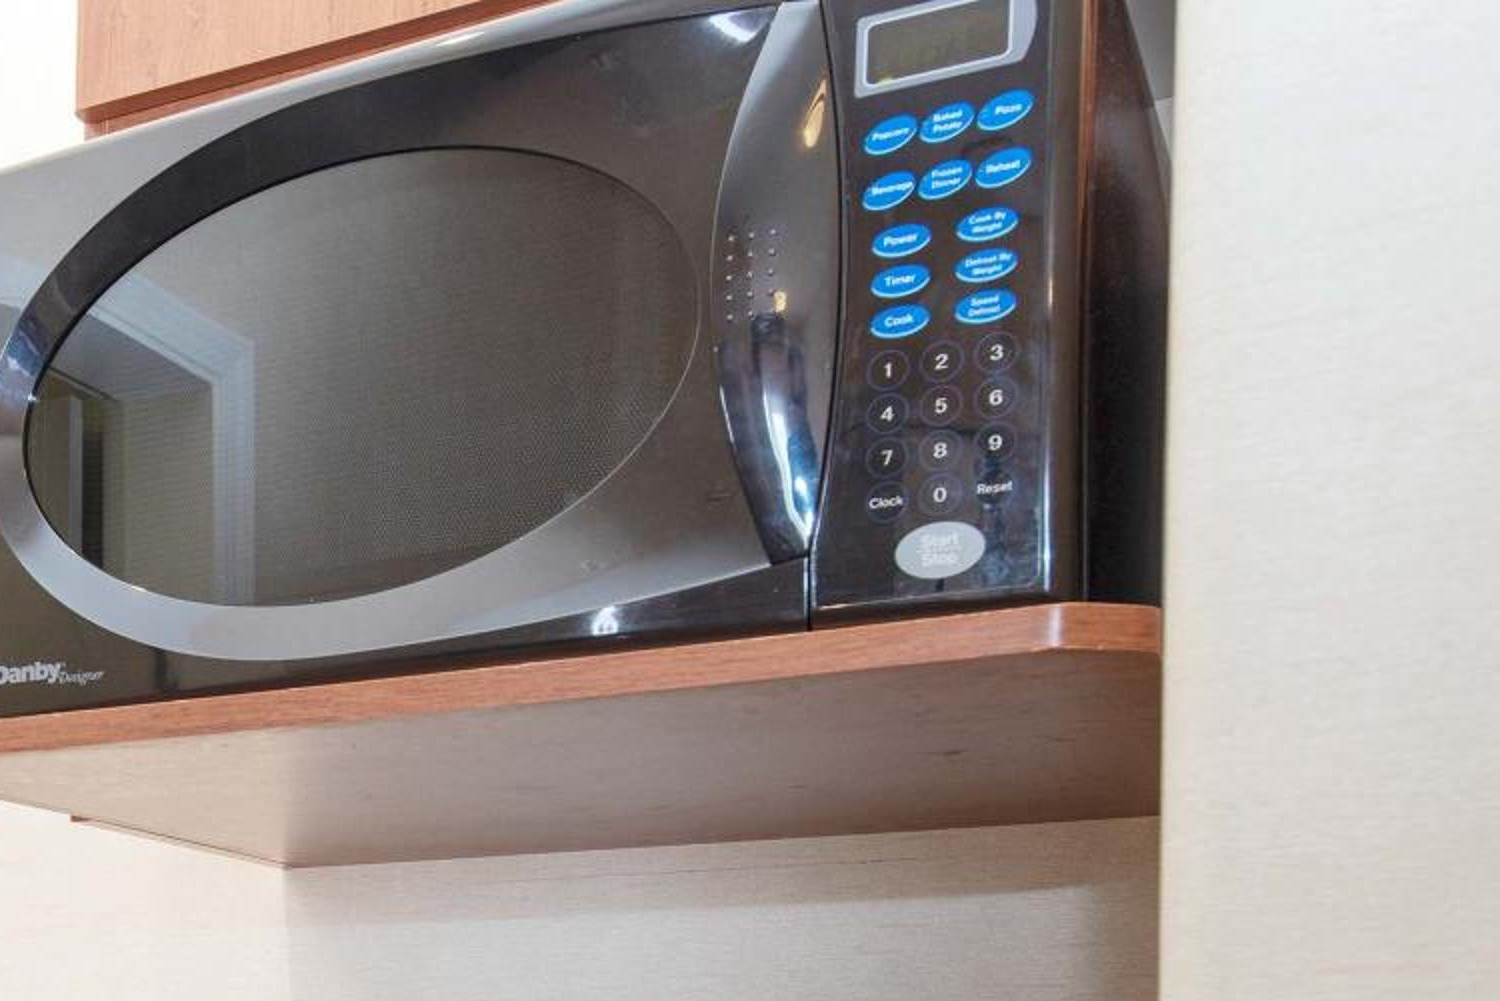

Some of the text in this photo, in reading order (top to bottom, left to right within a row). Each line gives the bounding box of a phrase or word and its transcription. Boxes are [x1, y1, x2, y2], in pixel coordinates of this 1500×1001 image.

[883, 232, 918, 248] Power
[884, 274, 915, 288] Timer
[884, 313, 914, 329] Cook
[990, 344, 1004, 361] 3
[934, 352, 949, 371] 2
[884, 363, 892, 378] 1
[989, 389, 1004, 406] 6
[880, 405, 894, 422] 4
[934, 397, 948, 415] 5
[933, 442, 948, 458] 8
[989, 435, 1003, 451] 9
[881, 449, 894, 467] 7
[933, 487, 948, 503] 0
[976, 480, 1014, 496] Reset
[868, 495, 905, 510] Clock
